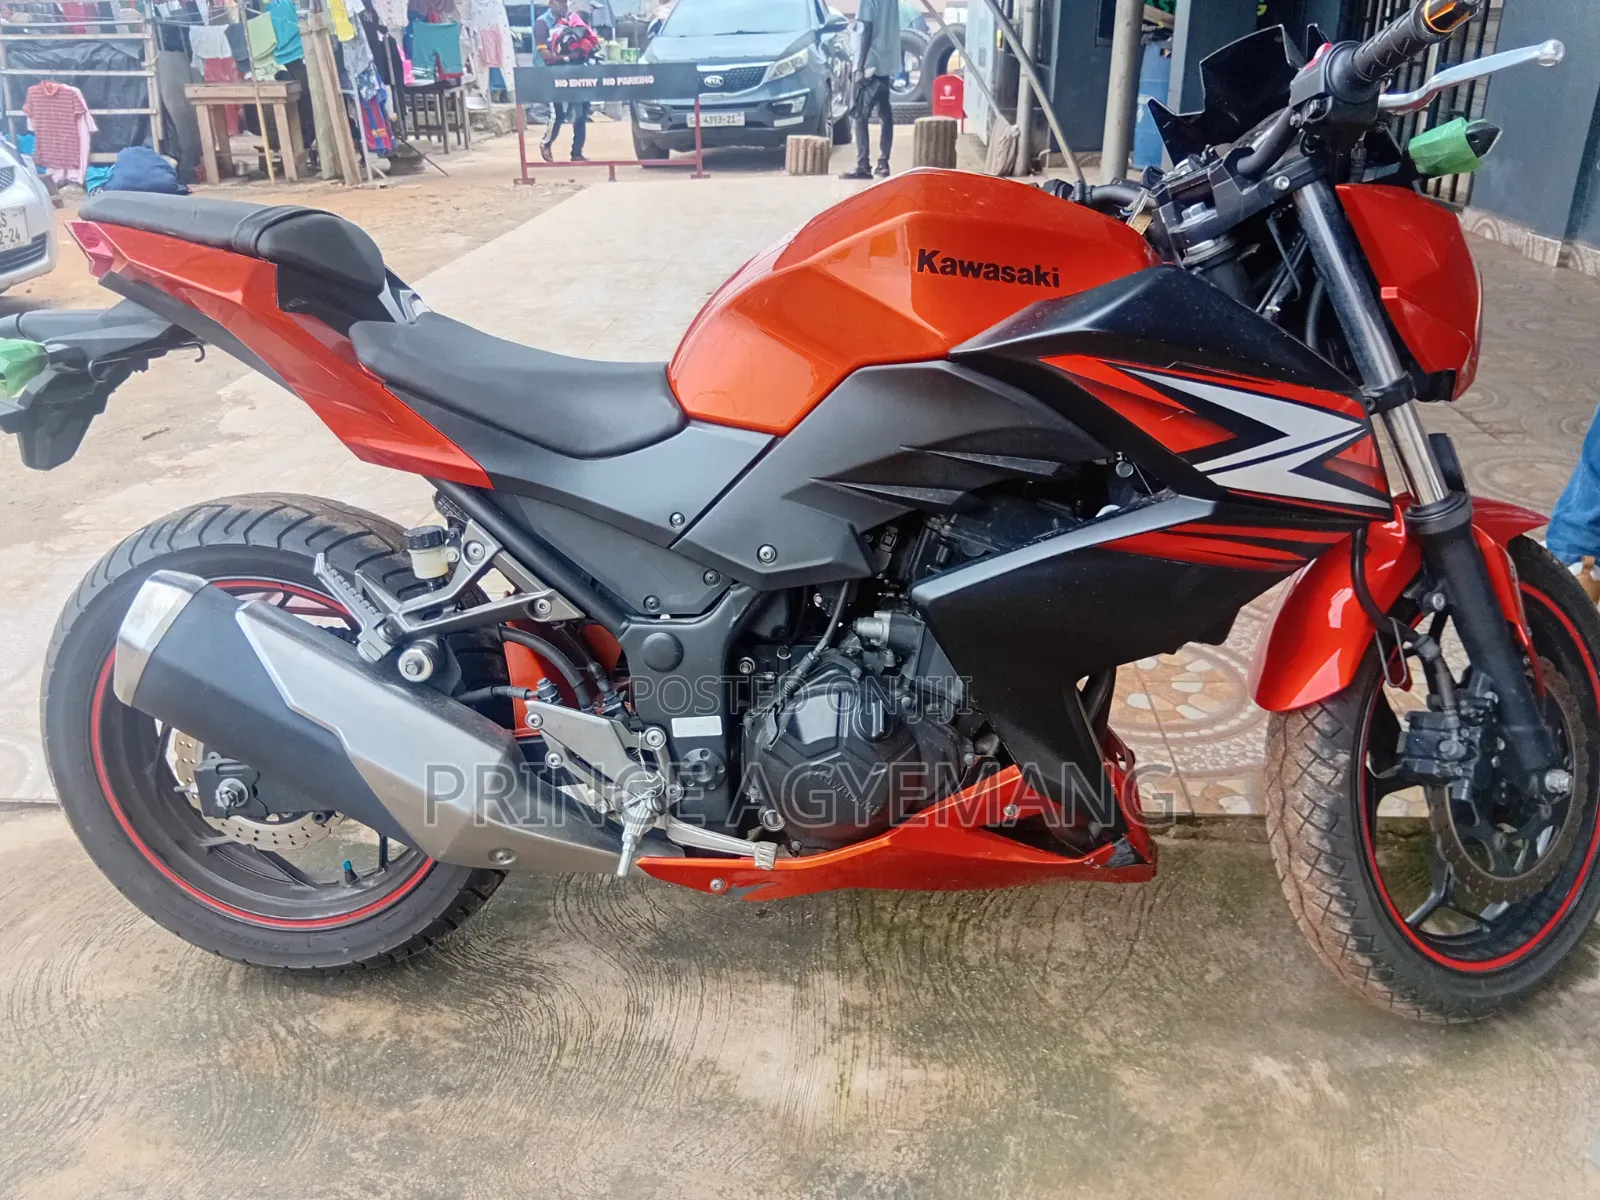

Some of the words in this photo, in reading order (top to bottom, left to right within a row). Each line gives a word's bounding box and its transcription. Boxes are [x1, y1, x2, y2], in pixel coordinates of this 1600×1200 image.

[554, 79, 568, 88] NO
[569, 78, 599, 88] ENTRY
[603, 77, 616, 86] NO
[617, 75, 655, 85] PARKING
[703, 115, 736, 125] 4393-21
[916, 248, 1060, 288] Kawasaki
